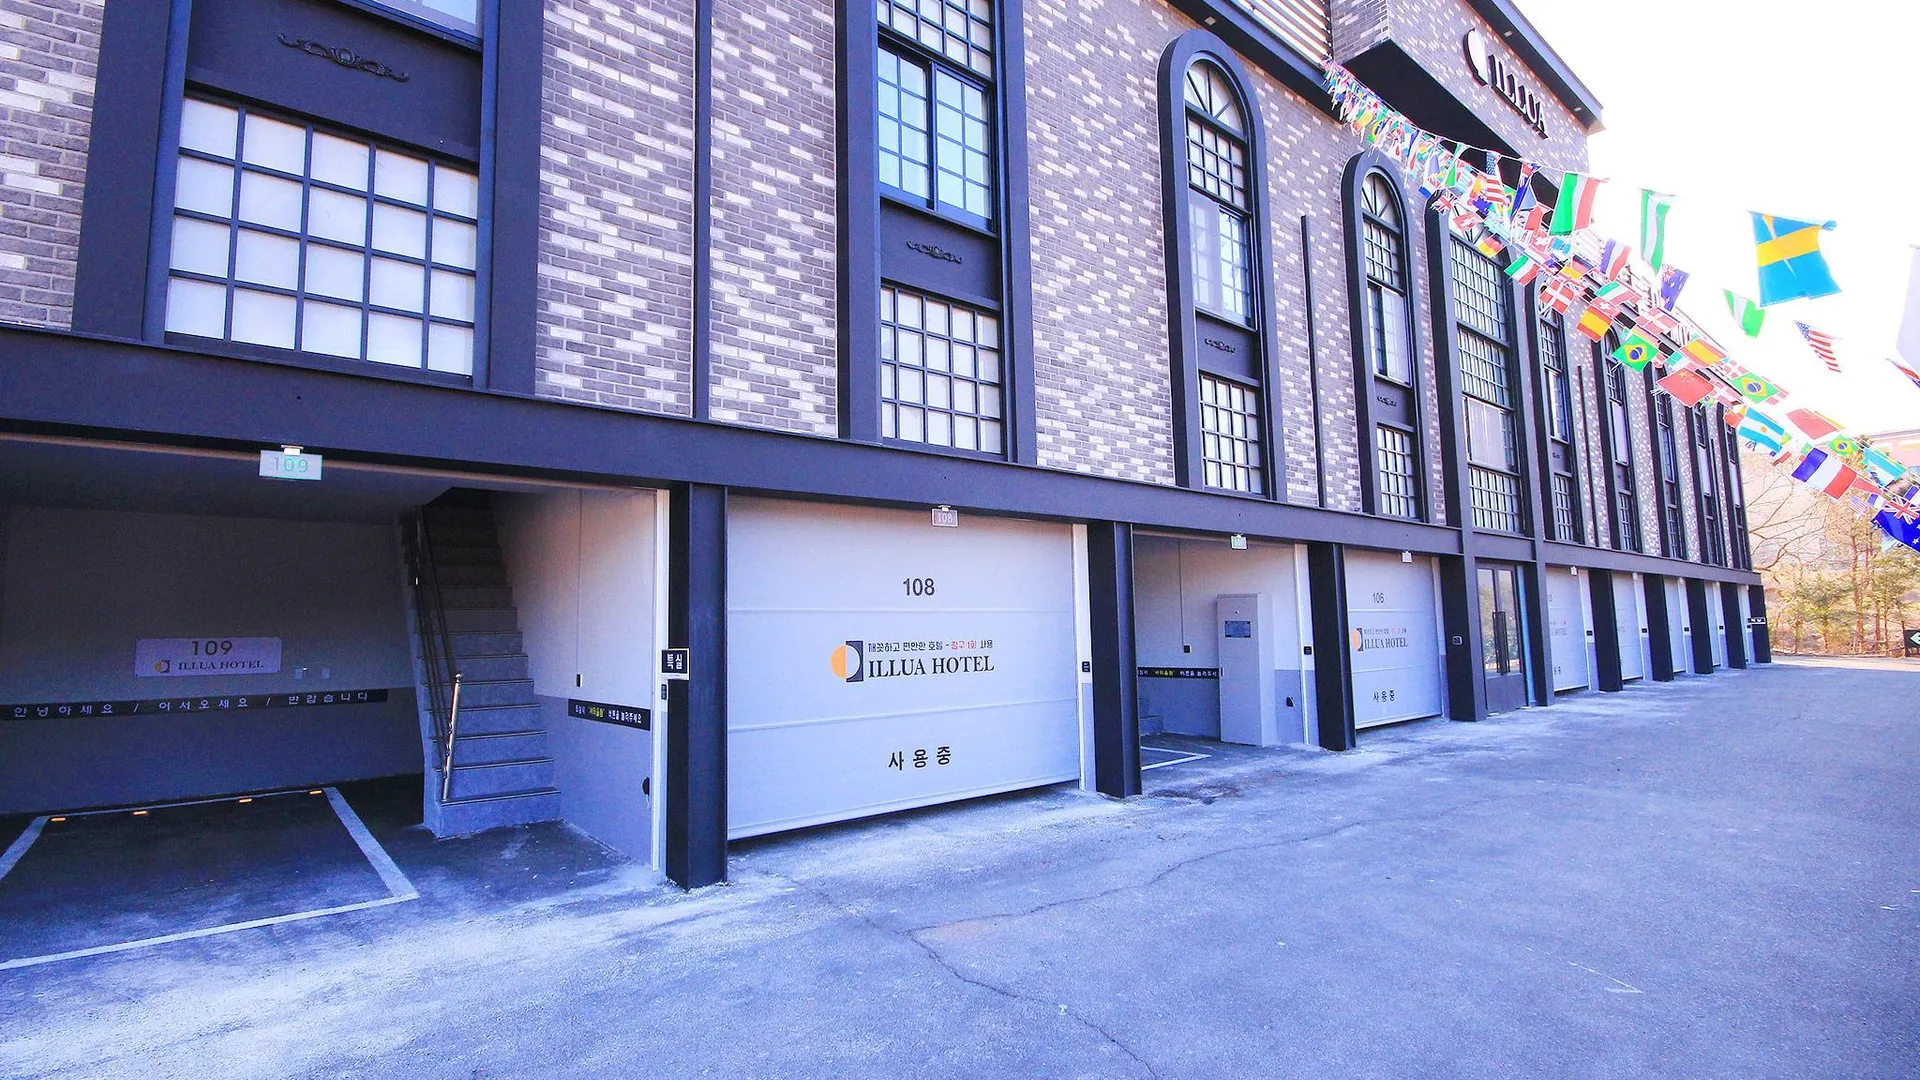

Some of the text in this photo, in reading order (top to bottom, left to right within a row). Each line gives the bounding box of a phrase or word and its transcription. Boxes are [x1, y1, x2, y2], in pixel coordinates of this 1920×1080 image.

[1488, 54, 1549, 140] ILLUA
[273, 456, 308, 473] 109
[938, 512, 953, 524] 108
[903, 577, 935, 596] 108
[1372, 592, 1385, 604] 106
[191, 640, 233, 656] 109
[1364, 637, 1408, 650] ILLUA HOTEL
[178, 660, 264, 671] ILLUA HOTEL
[667, 653, 683, 670] 특실
[868, 655, 995, 678] ILLUA HOTEL
[14, 703, 114, 718] 안녕하세요
[158, 697, 248, 711] 어서오세요
[288, 691, 368, 705] 반갑습니다
